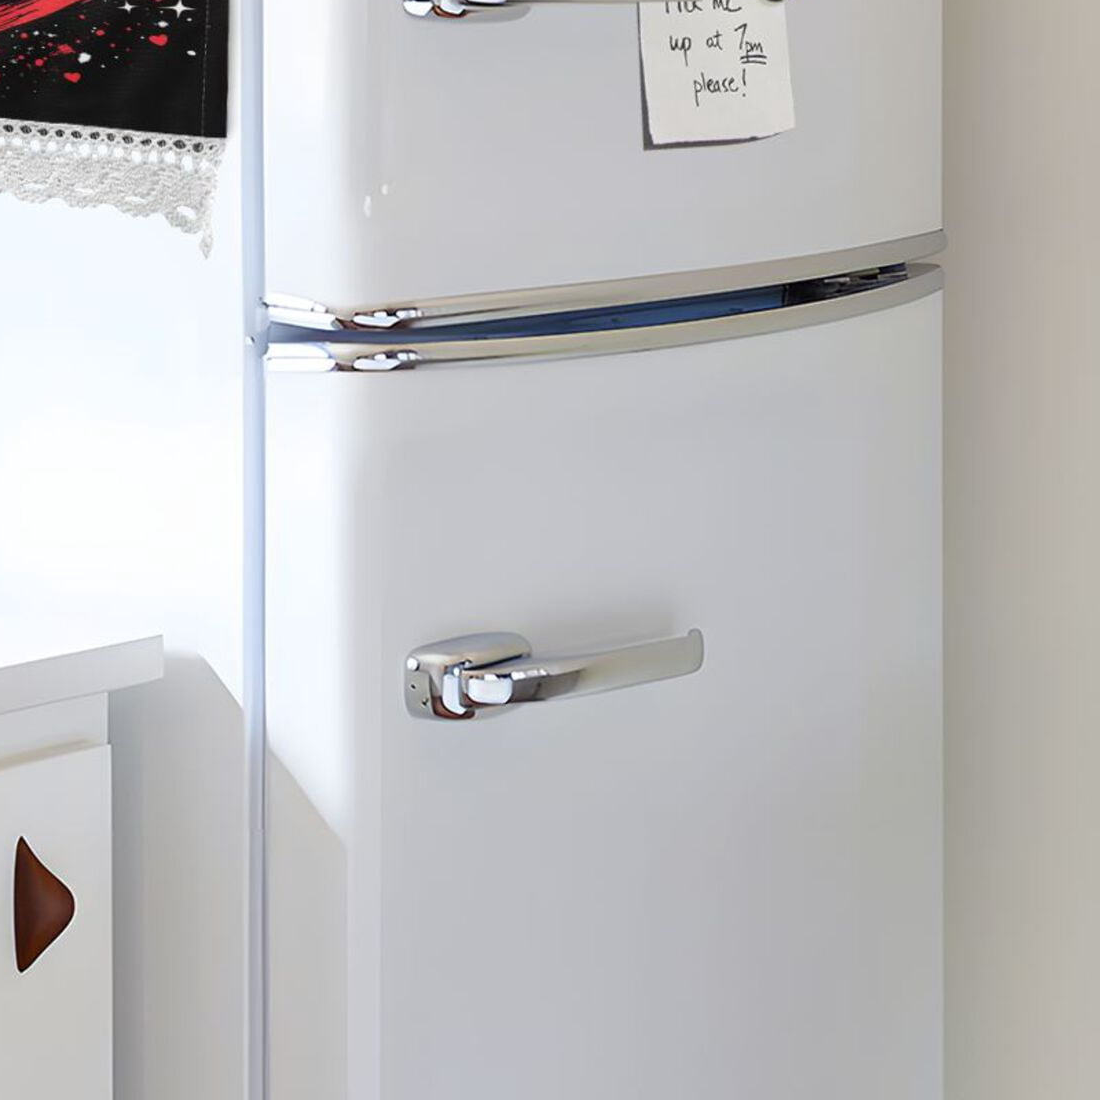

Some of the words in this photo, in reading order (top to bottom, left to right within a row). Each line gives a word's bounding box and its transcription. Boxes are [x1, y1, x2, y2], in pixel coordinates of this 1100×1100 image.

[669, 35, 692, 66] up
[706, 30, 723, 50] at
[693, 68, 746, 107] please!
